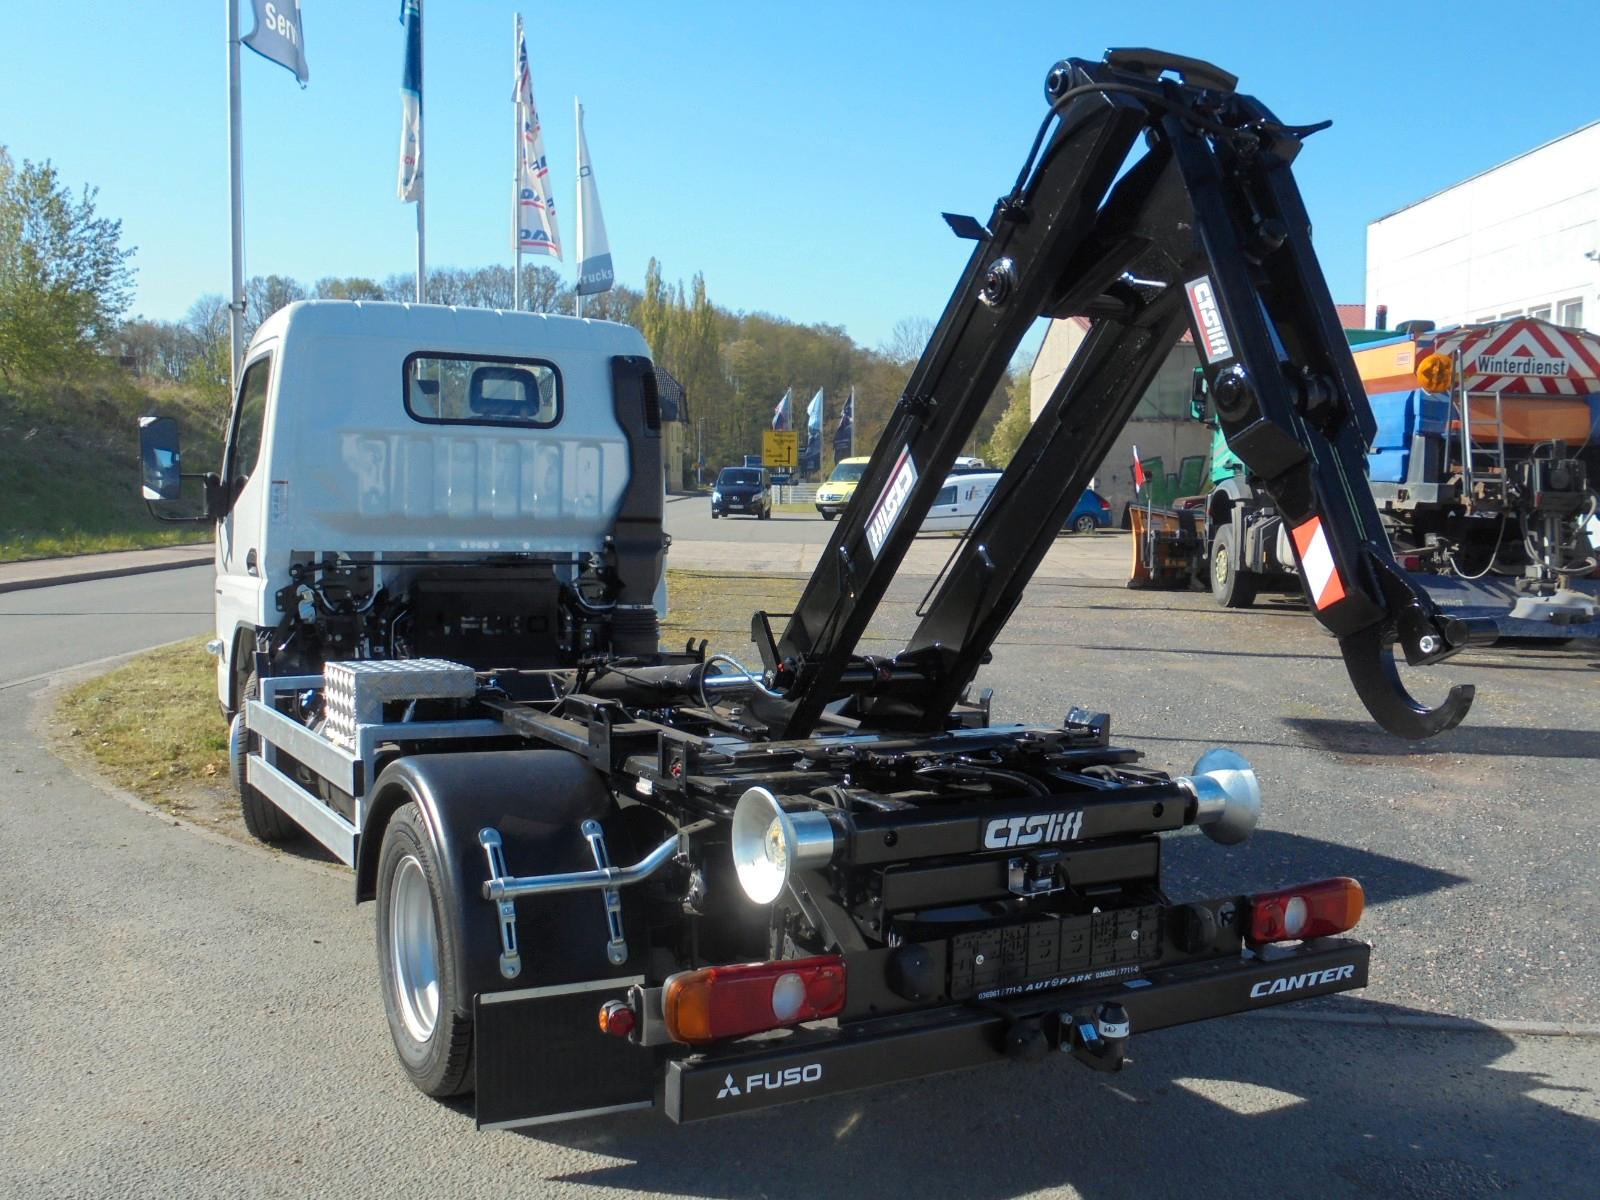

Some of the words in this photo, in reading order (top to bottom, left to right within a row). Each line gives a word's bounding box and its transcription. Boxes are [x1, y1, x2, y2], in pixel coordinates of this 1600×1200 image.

[1194, 282, 1228, 355] CTSlift
[1478, 355, 1567, 376] Winterdienst
[984, 811, 1084, 849] CTSlift
[1025, 972, 1093, 991] AUTOPARK
[1250, 964, 1355, 998] CANTER
[746, 1063, 822, 1093] FUSO
